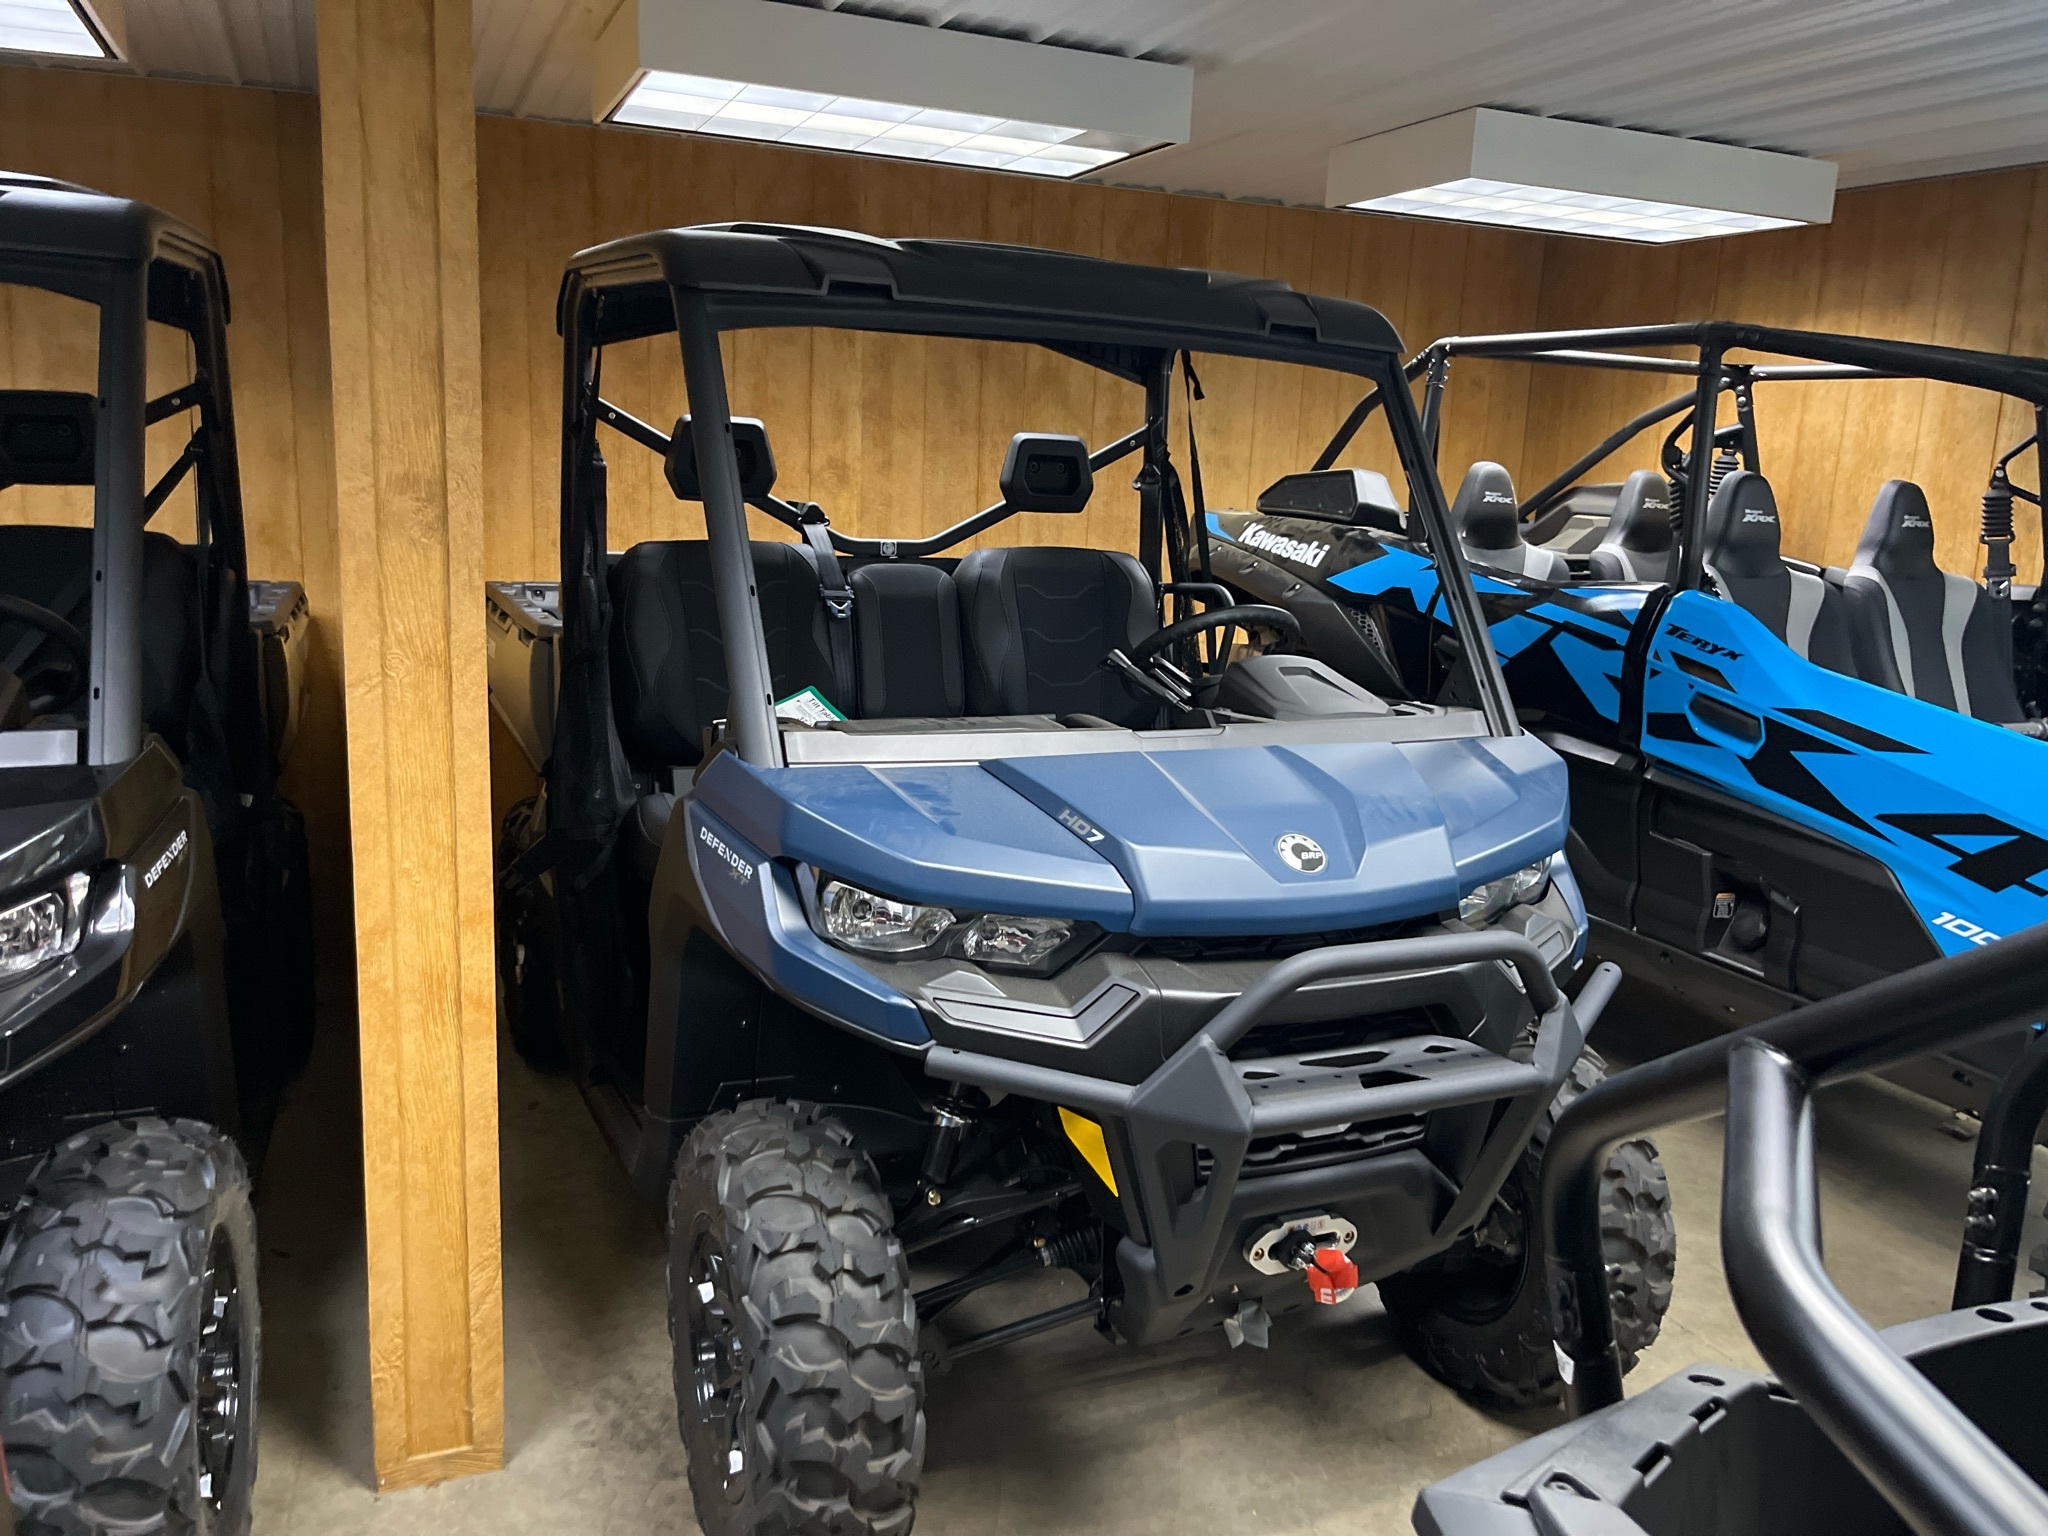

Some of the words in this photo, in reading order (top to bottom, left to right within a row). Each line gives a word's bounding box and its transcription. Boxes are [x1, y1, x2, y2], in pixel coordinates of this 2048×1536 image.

[1238, 522, 1331, 569] Kawasaki
[1058, 808, 1105, 843] HD7
[144, 829, 188, 889] DEFENDER
[699, 825, 753, 880] DEFENDER
[1300, 851, 1322, 861] BRP
